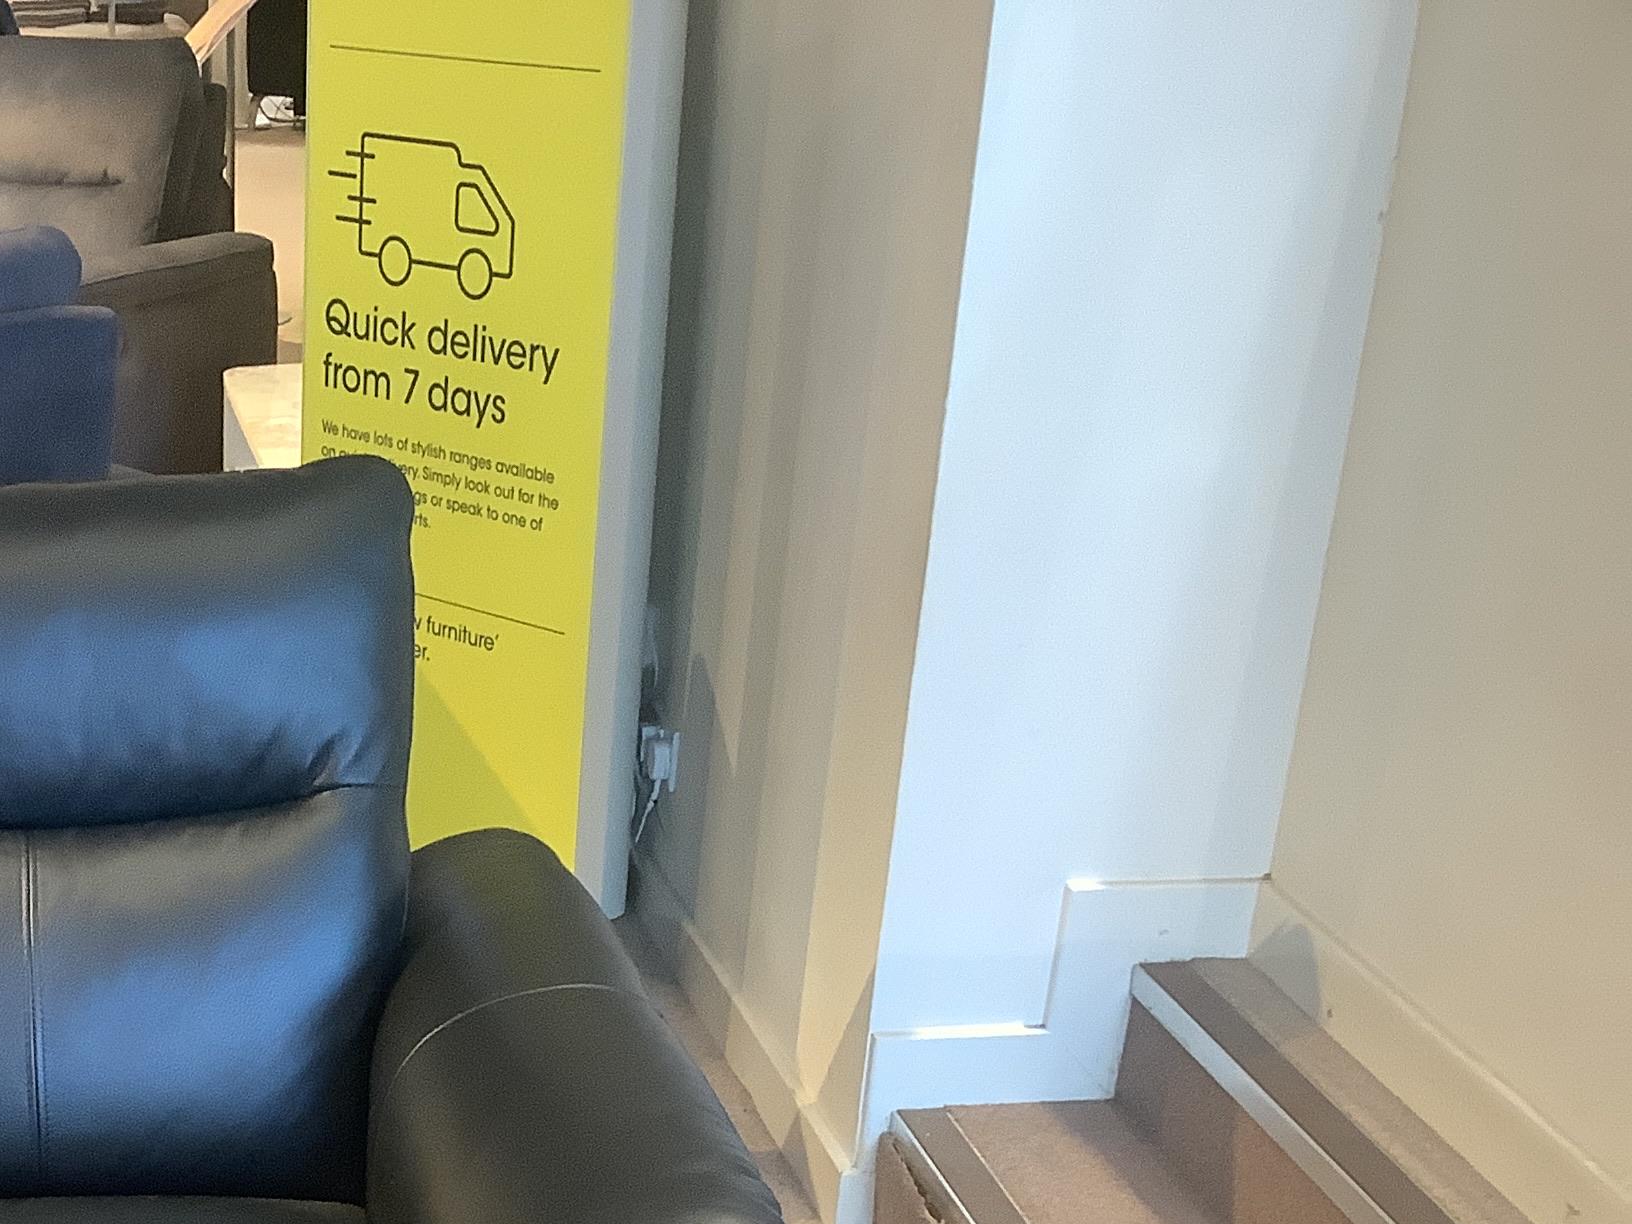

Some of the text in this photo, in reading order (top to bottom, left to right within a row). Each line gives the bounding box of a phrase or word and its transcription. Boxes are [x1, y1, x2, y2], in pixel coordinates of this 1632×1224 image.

[325, 298, 560, 385] Quick delivery
[323, 352, 506, 429] from 7 days
[321, 418, 555, 484] We have lots of stylish ranges available
[321, 445, 336, 457] on
[422, 466, 462, 491] Simply
[464, 475, 490, 496] look
[494, 484, 515, 500] out
[518, 487, 534, 505] for
[538, 493, 560, 511] the
[431, 495, 443, 507] or
[446, 498, 483, 518] speak
[486, 506, 498, 521] to
[502, 512, 526, 528] one
[530, 517, 543, 533] of
